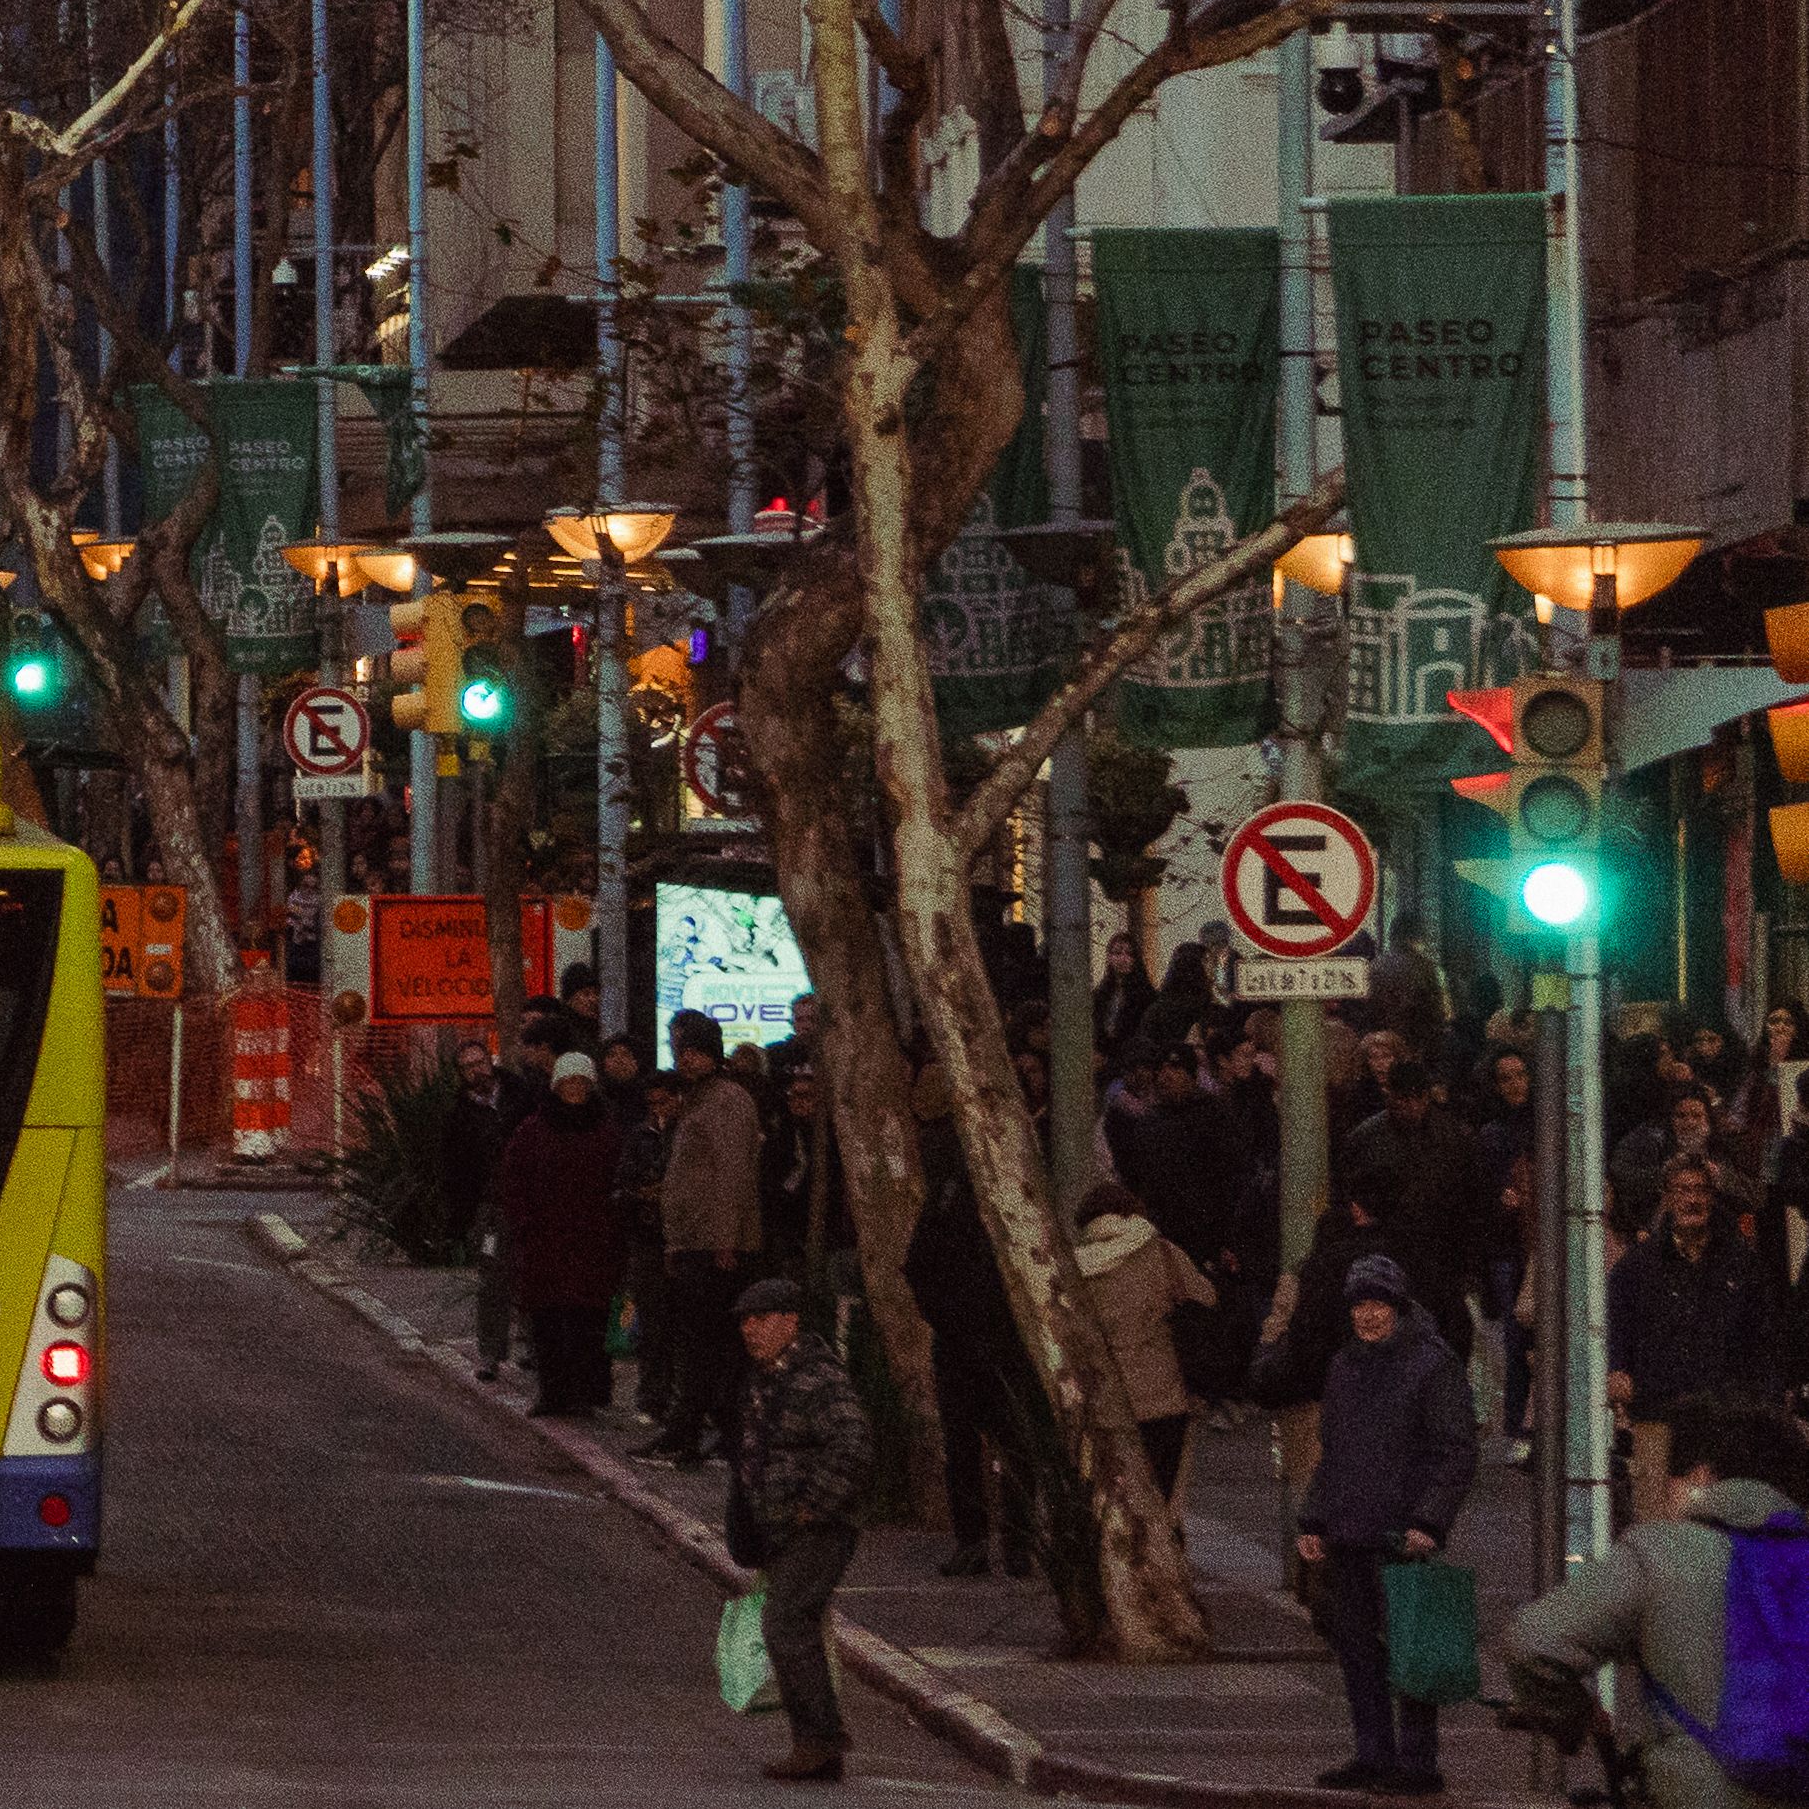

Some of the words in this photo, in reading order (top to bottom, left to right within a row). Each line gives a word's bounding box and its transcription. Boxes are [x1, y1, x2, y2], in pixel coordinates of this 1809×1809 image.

[1120, 332, 1236, 354] PASEO
[1362, 318, 1493, 346] PASEO
[1120, 362, 1264, 385] CENTRO
[1362, 352, 1523, 381] CENTRO
[150, 436, 211, 451] PASEO
[229, 440, 291, 455] PASEO
[229, 456, 306, 472] CENTRO
[310, 706, 344, 756] E
[1266, 836, 1326, 925] E
[446, 949, 472, 969] LA
